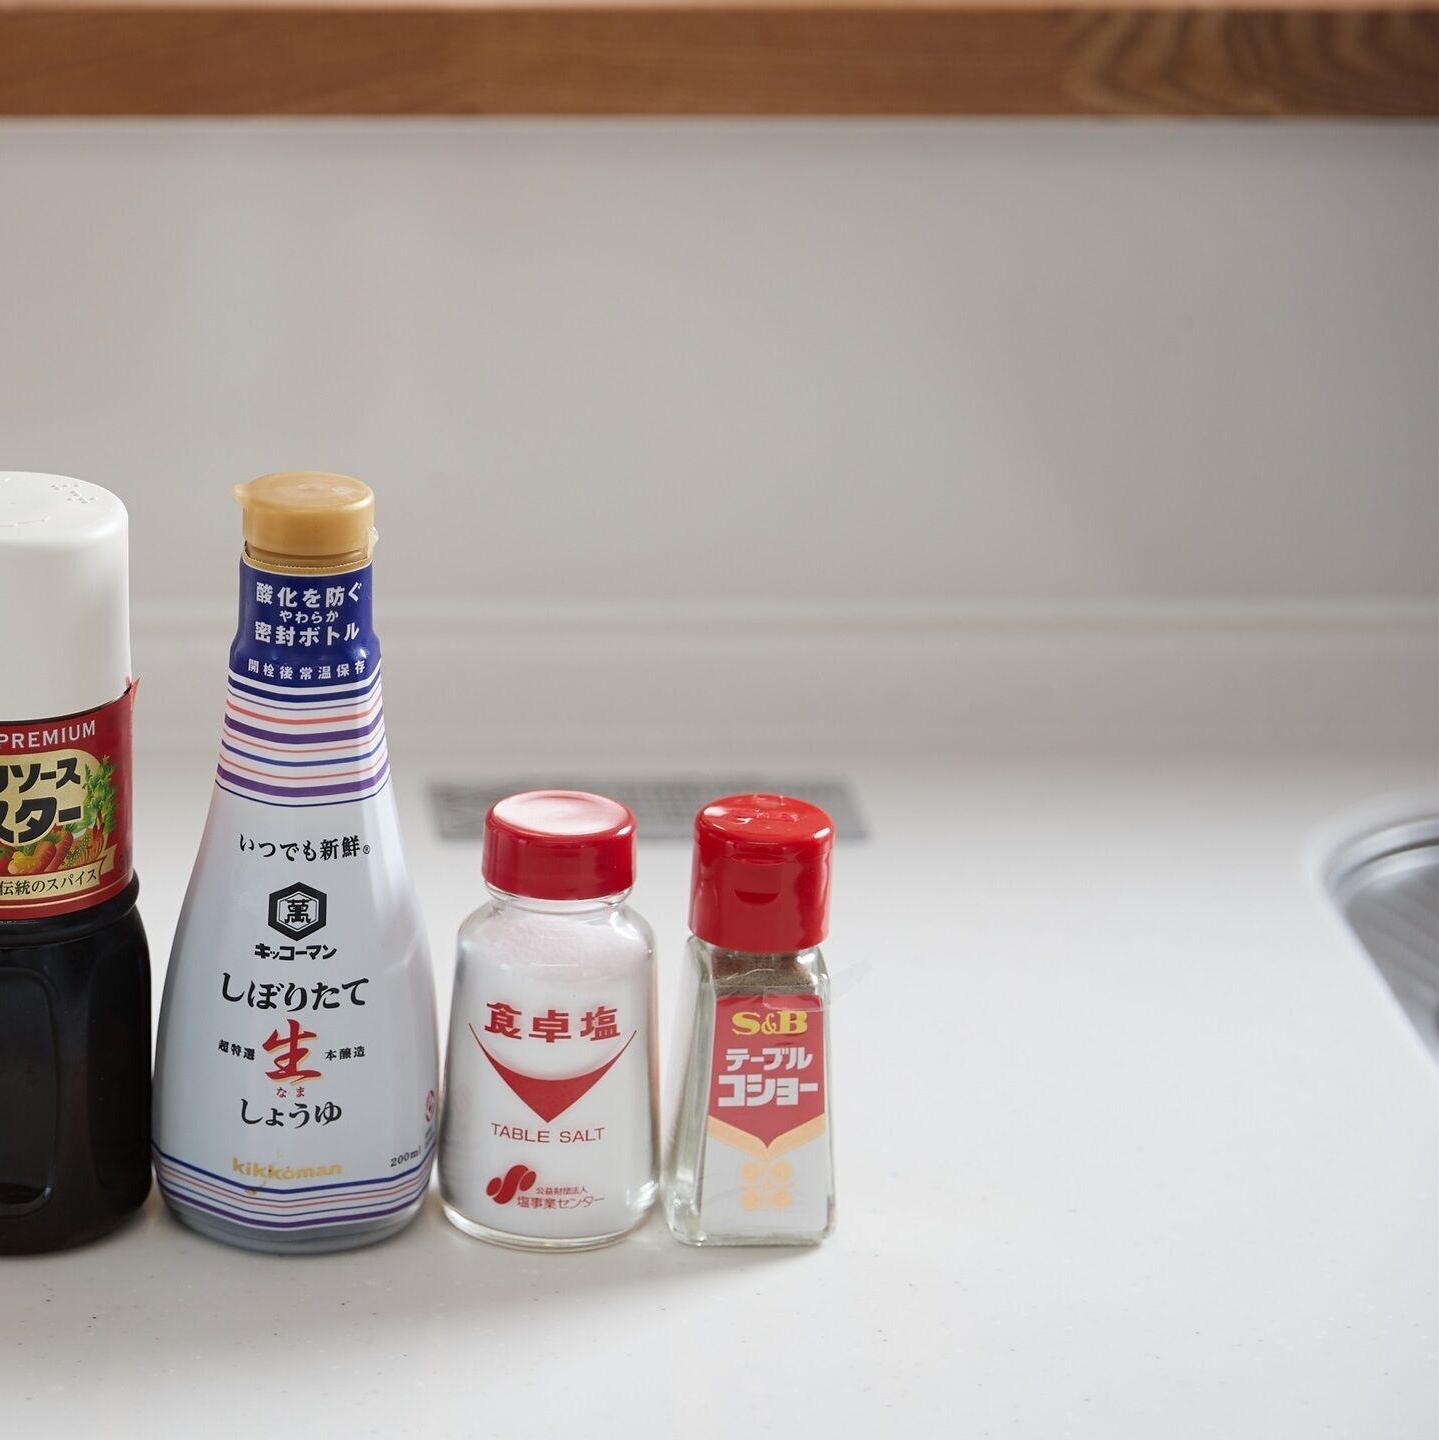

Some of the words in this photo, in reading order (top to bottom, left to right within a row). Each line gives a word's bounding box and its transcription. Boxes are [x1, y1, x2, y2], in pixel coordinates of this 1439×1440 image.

[256, 581, 363, 608] 酸化を防ぐ
[279, 609, 340, 624] やわらか
[254, 621, 360, 647] 密封ボトル
[247, 658, 366, 680] 開栓後常温保存
[254, 943, 338, 961] キッコーマン
[220, 972, 370, 1013] しぼりたて
[484, 1002, 621, 1043] 食卓塩
[732, 1010, 808, 1036] S&B
[261, 1018, 323, 1086] 生
[726, 1047, 813, 1071] テーブル
[276, 1086, 306, 1098] なま
[718, 1073, 818, 1107] コショー
[240, 1098, 343, 1129] しょうゆ
[491, 1122, 550, 1143] TABLE
[559, 1127, 605, 1143] SALT
